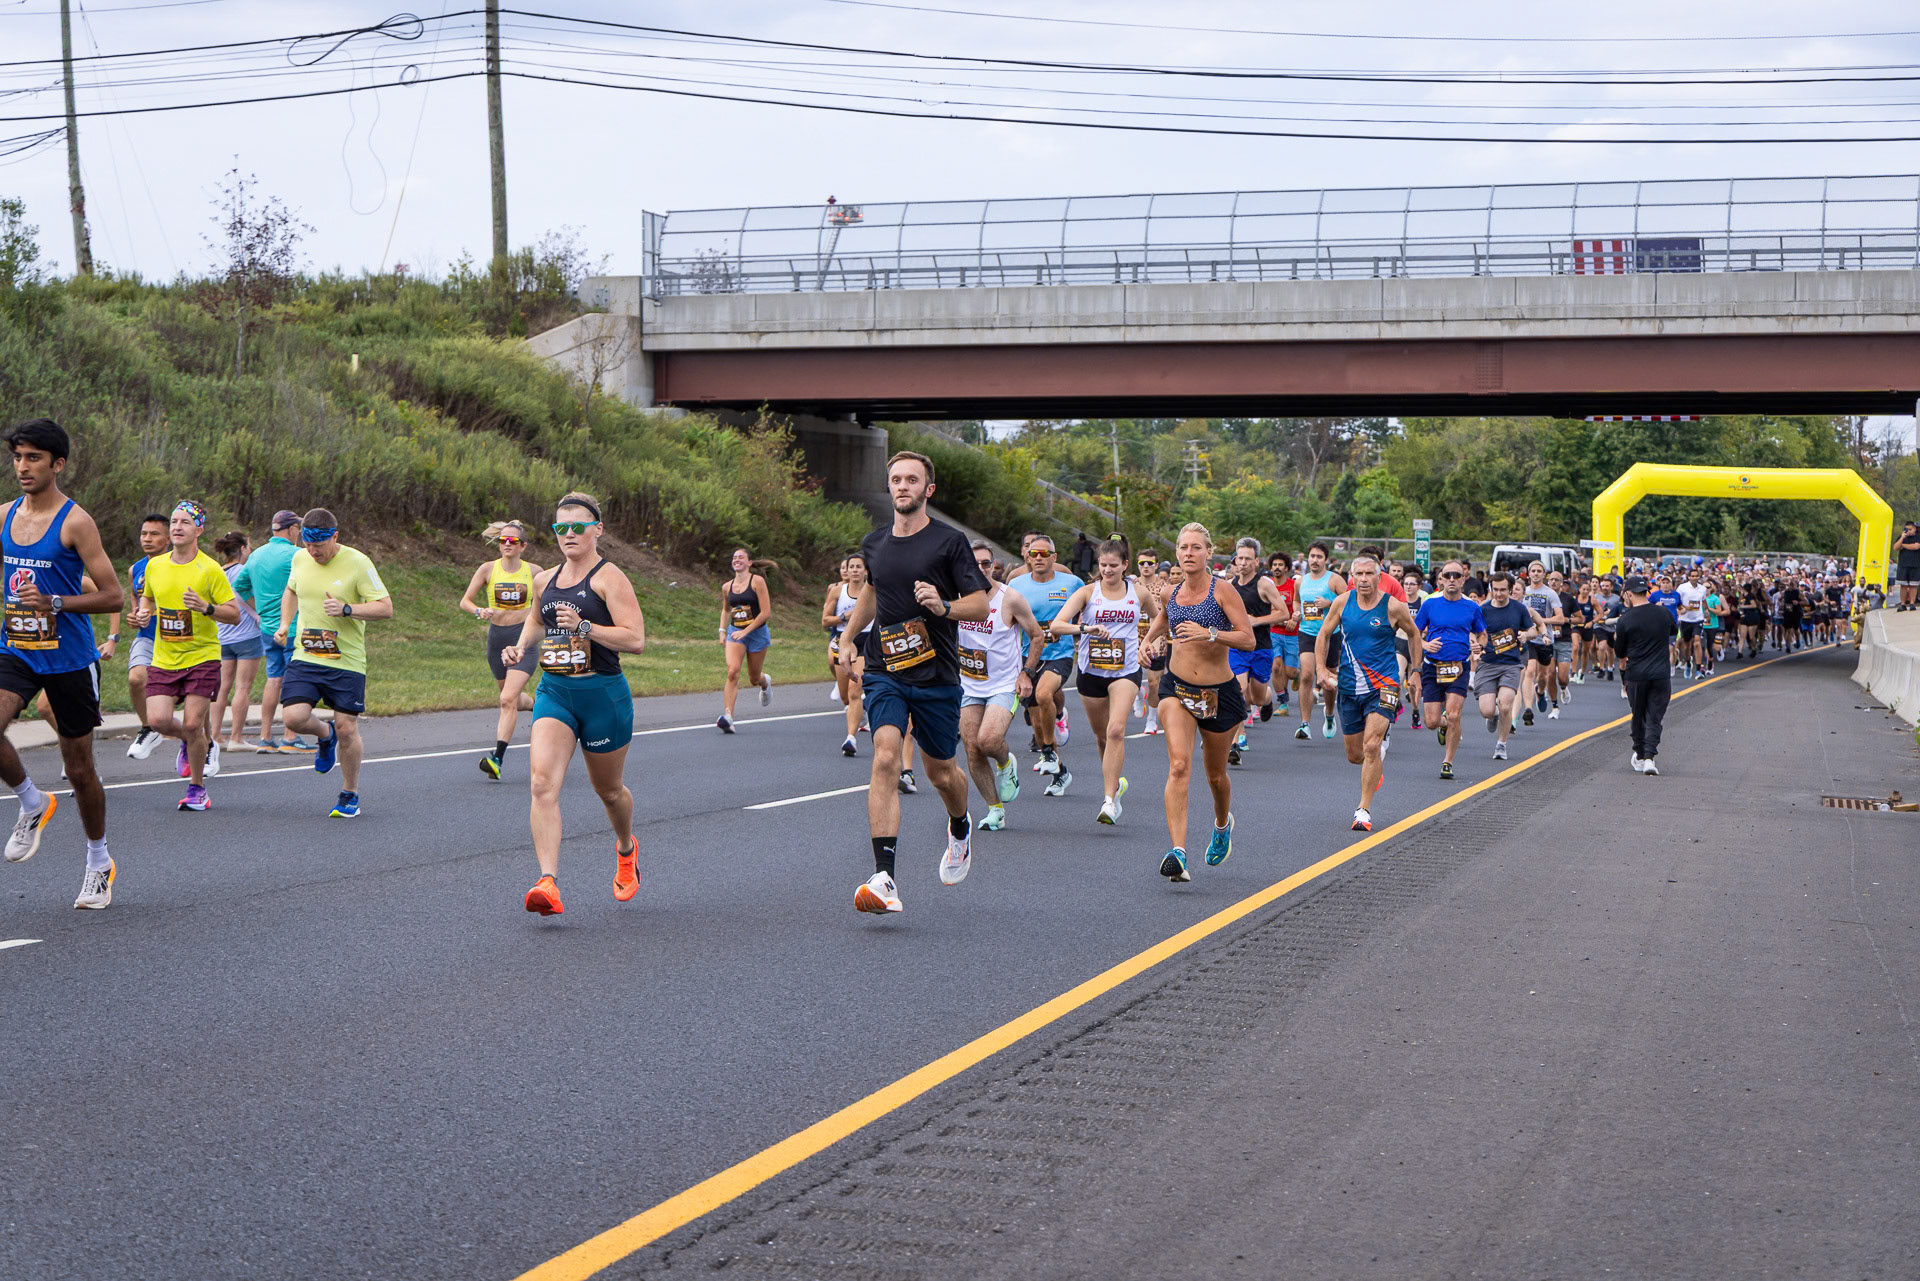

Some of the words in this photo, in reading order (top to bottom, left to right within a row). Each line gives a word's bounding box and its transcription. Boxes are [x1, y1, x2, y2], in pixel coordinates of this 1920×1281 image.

[3, 555, 19, 565] ENN
[19, 558, 52, 568] RELAYS
[501, 591, 520, 600] 98
[1095, 610, 1135, 619] LEONIA
[11, 617, 48, 632] 331
[162, 618, 185, 630] 118
[976, 626, 993, 635] CLUB
[303, 639, 334, 649] 345
[886, 634, 923, 654] 132
[543, 650, 586, 665] 332
[1091, 647, 1122, 658] 236
[1440, 666, 1460, 675] 219
[586, 737, 610, 746] HOKA
